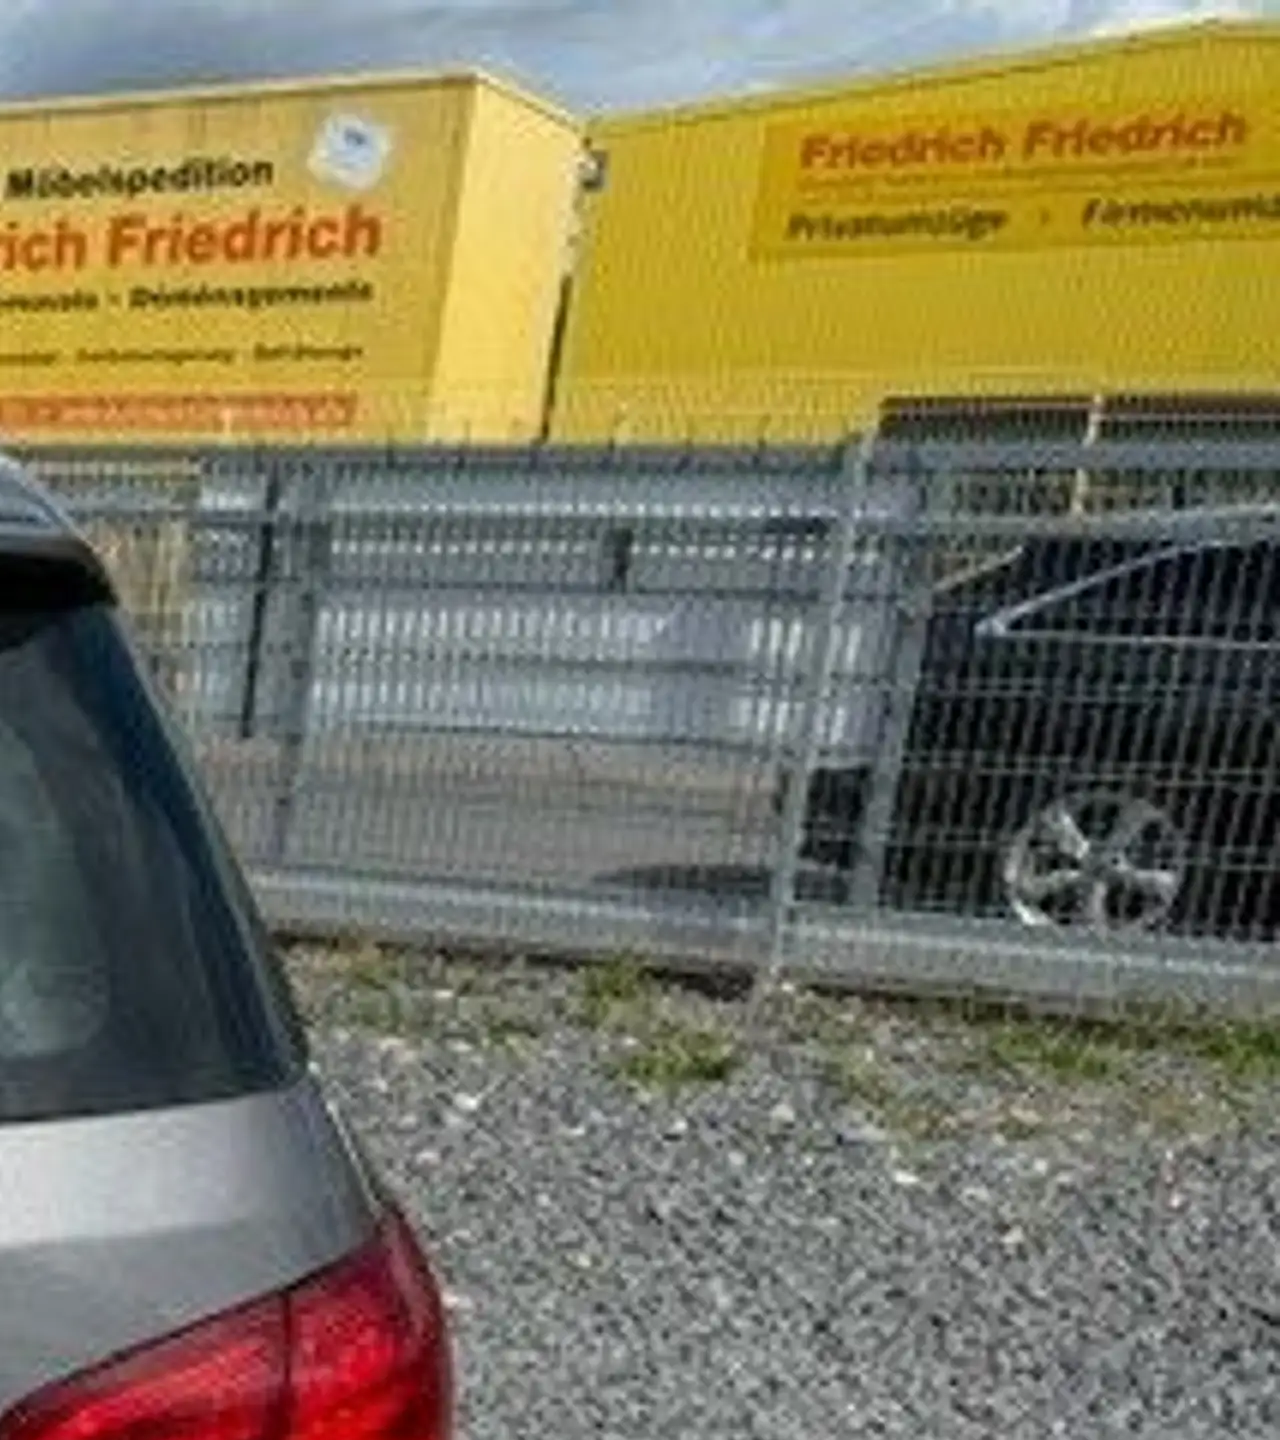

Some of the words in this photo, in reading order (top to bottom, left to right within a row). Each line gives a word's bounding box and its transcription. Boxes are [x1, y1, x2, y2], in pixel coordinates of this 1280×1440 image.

[800, 128, 1006, 170] Friedrich
[1022, 112, 1245, 160] Friedrich
[3, 158, 274, 199] Möbelspedition
[104, 203, 382, 268] Friedrich
